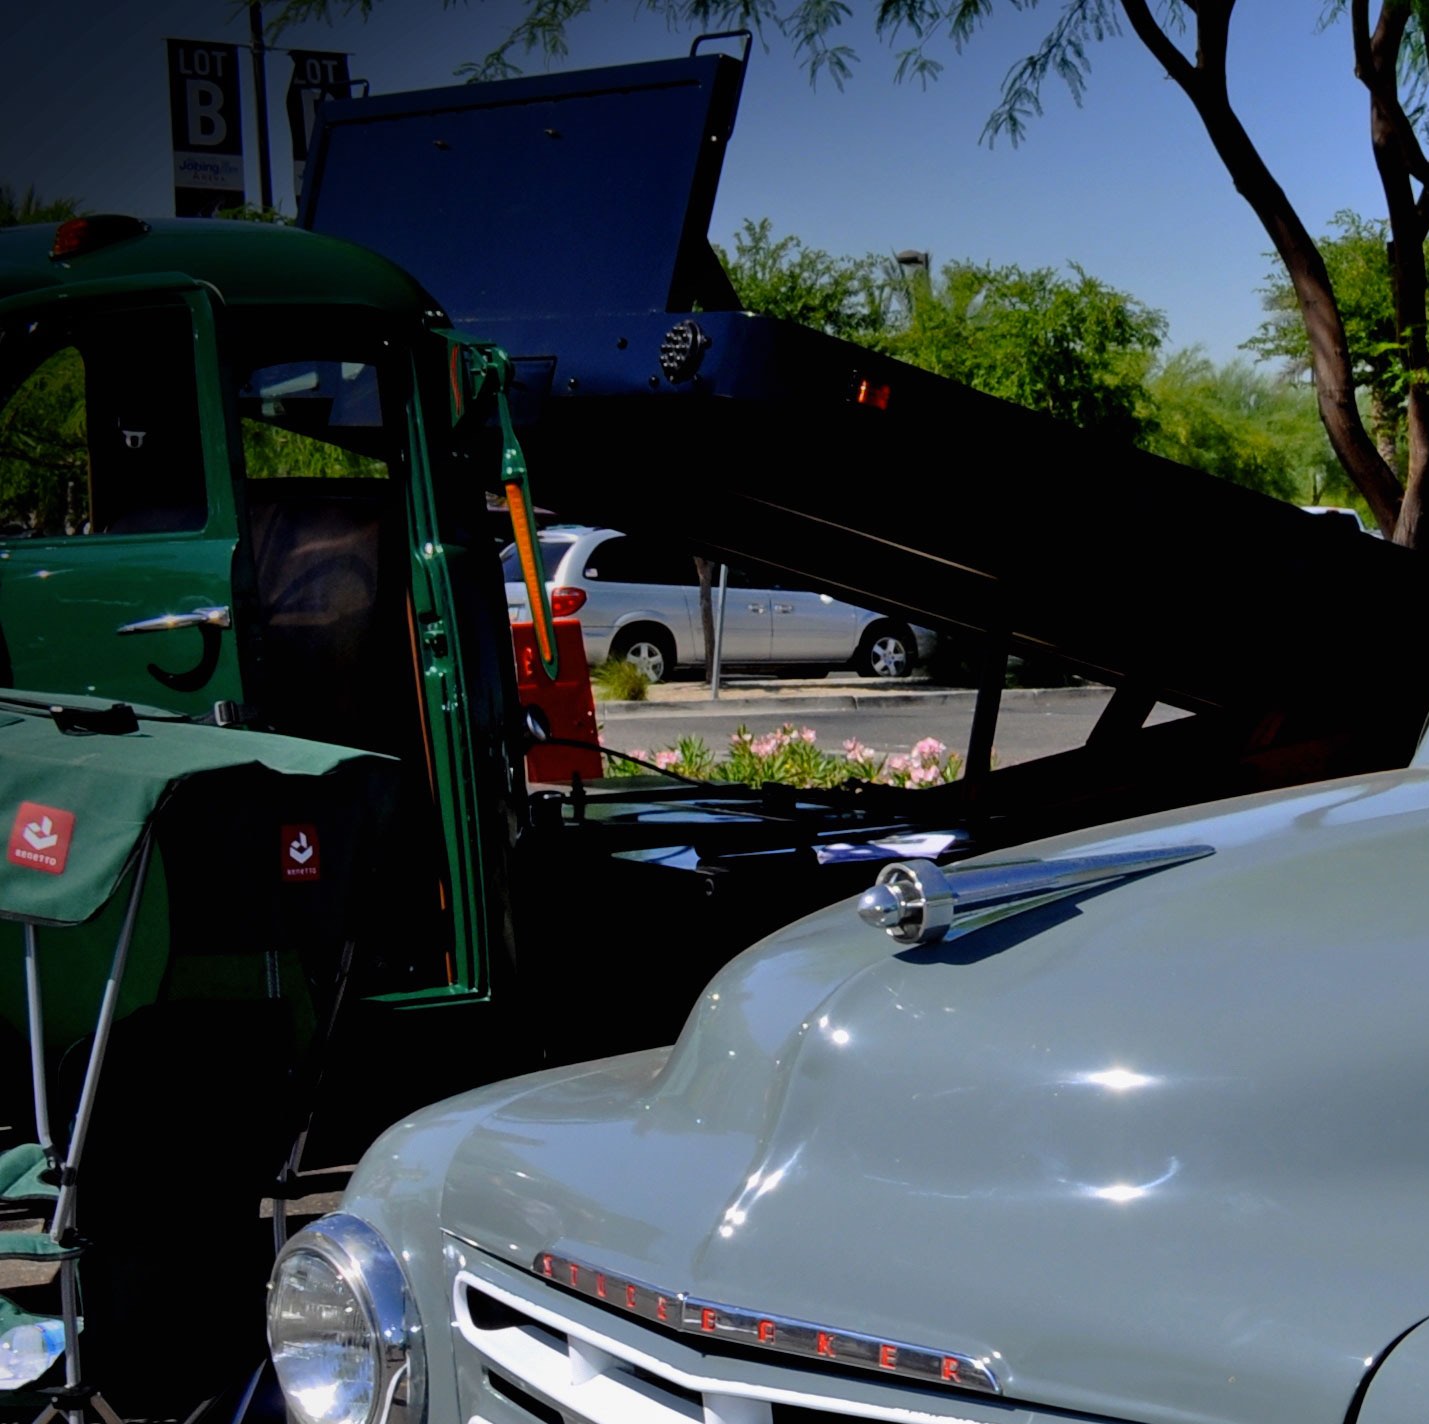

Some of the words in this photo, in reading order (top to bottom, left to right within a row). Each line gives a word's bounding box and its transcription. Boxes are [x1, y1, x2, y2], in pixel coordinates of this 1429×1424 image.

[177, 47, 228, 78] LOT
[186, 79, 228, 147] B
[541, 1253, 962, 1383] STUDEBAKER
